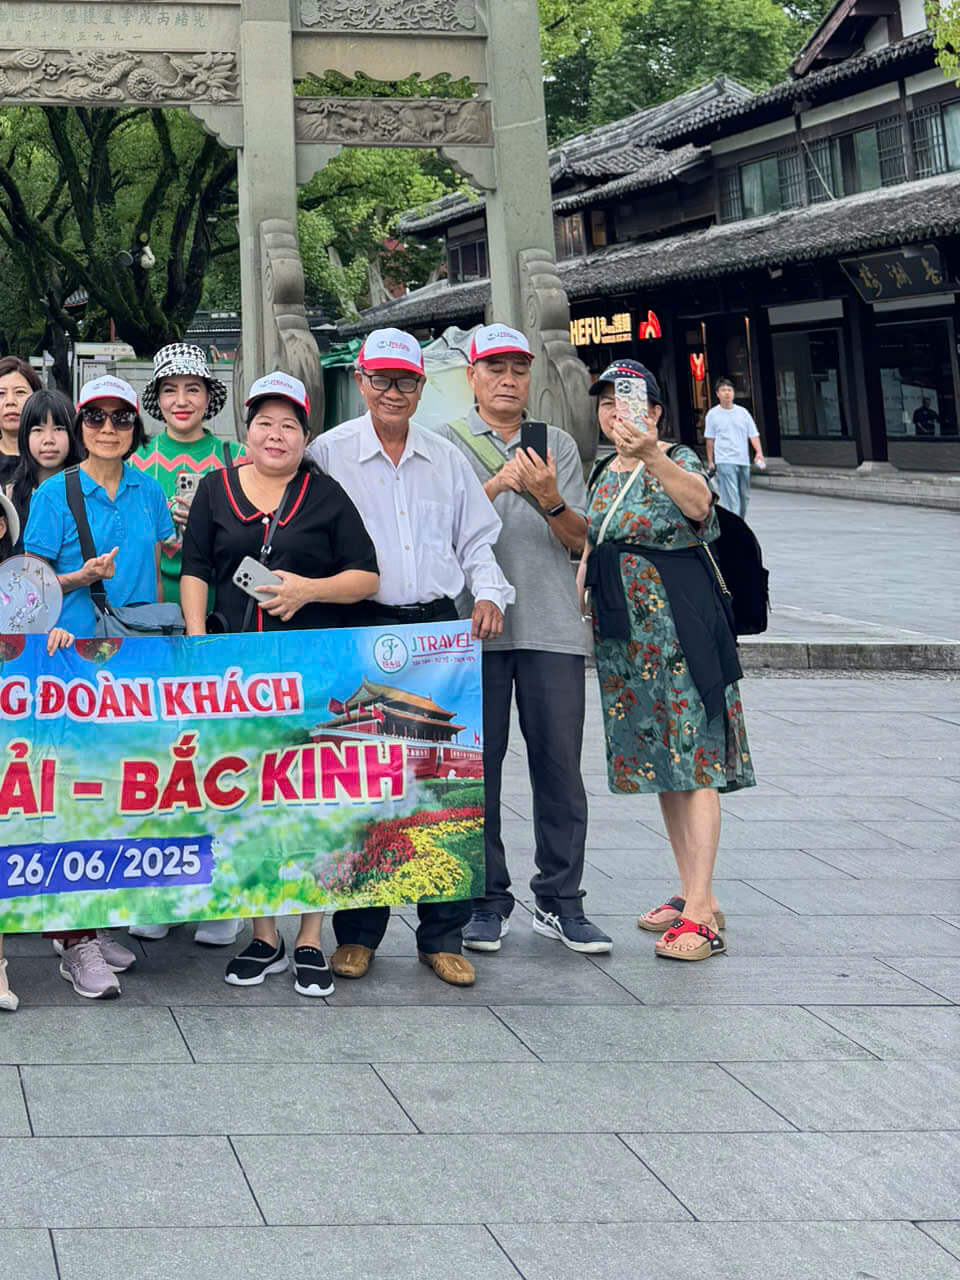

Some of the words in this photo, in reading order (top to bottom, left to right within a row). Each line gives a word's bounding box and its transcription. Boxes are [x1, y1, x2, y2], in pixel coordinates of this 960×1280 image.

[569, 316, 601, 346] HEFU
[39, 676, 153, 718] ĐOÀN
[162, 672, 300, 716] KHÁCH
[120, 734, 249, 813] BẮC
[260, 744, 404, 802] KINH
[7, 845, 201, 888] 26/06/2025
